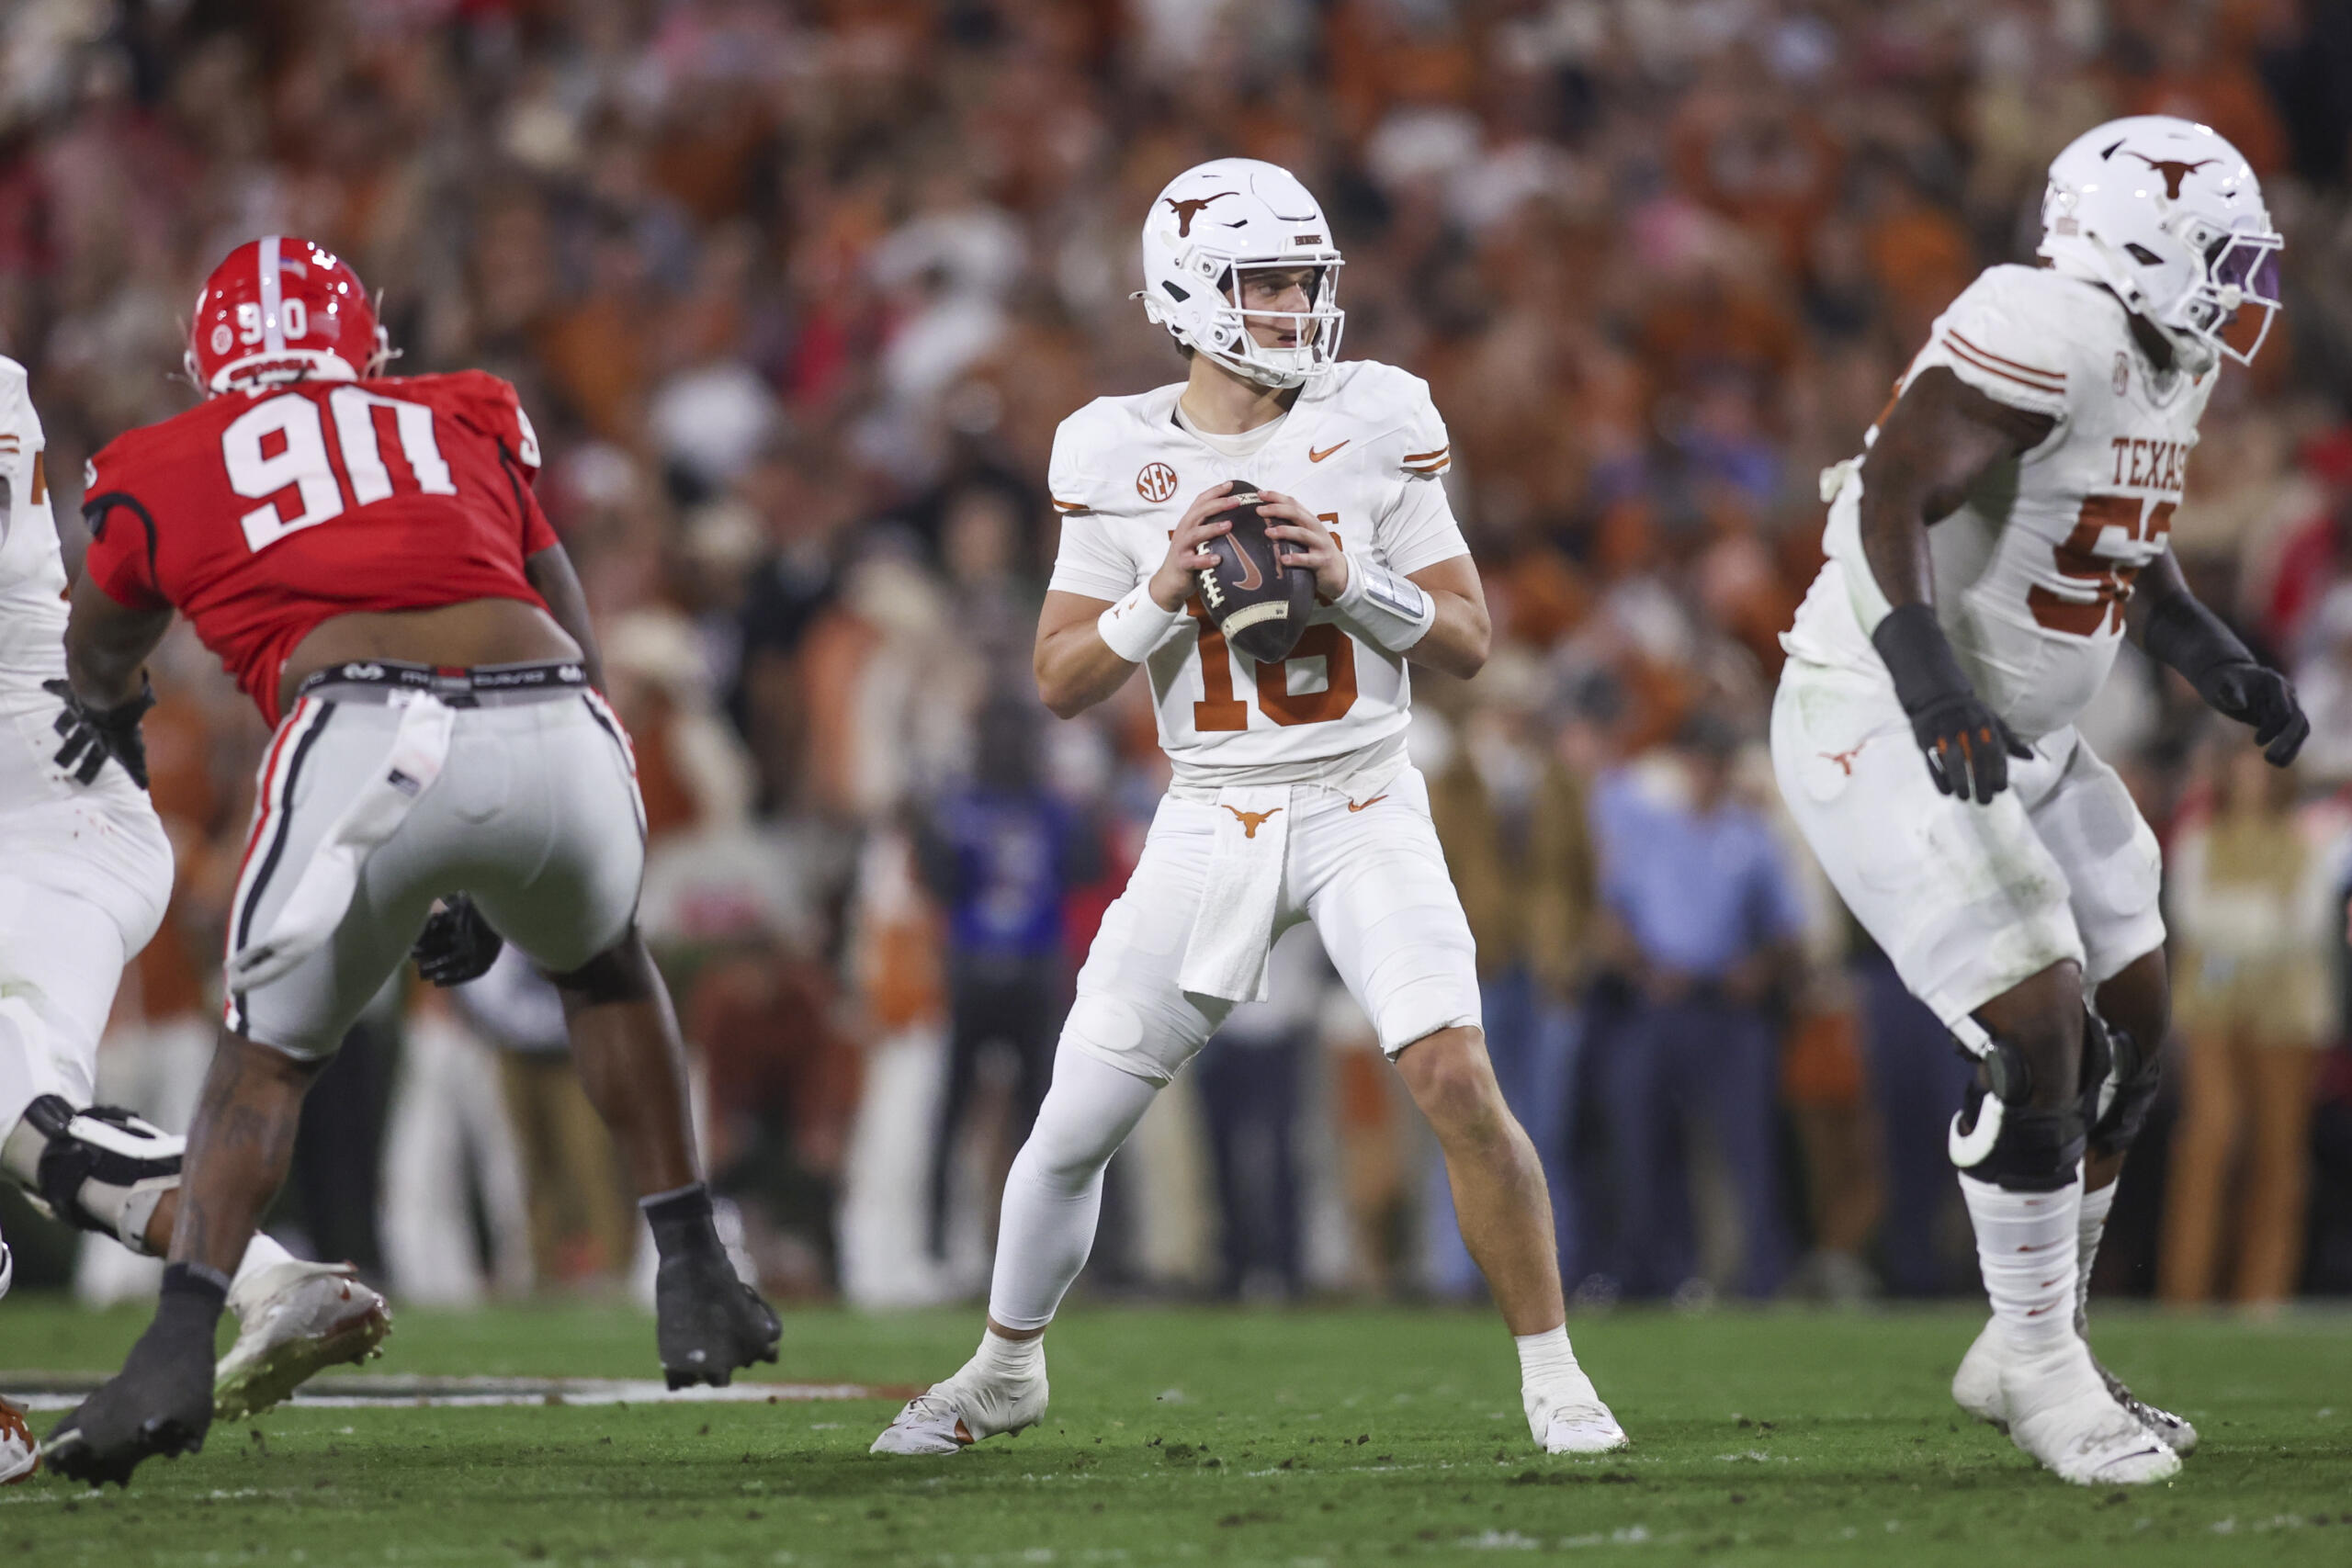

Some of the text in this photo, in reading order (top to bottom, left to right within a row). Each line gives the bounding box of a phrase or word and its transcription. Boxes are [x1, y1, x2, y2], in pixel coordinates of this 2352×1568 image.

[237, 298, 308, 345] 90
[221, 384, 458, 553] 90
[1136, 462, 1178, 502] SEC
[2110, 436, 2188, 492] TEXAS
[1185, 588, 1359, 729] 16
